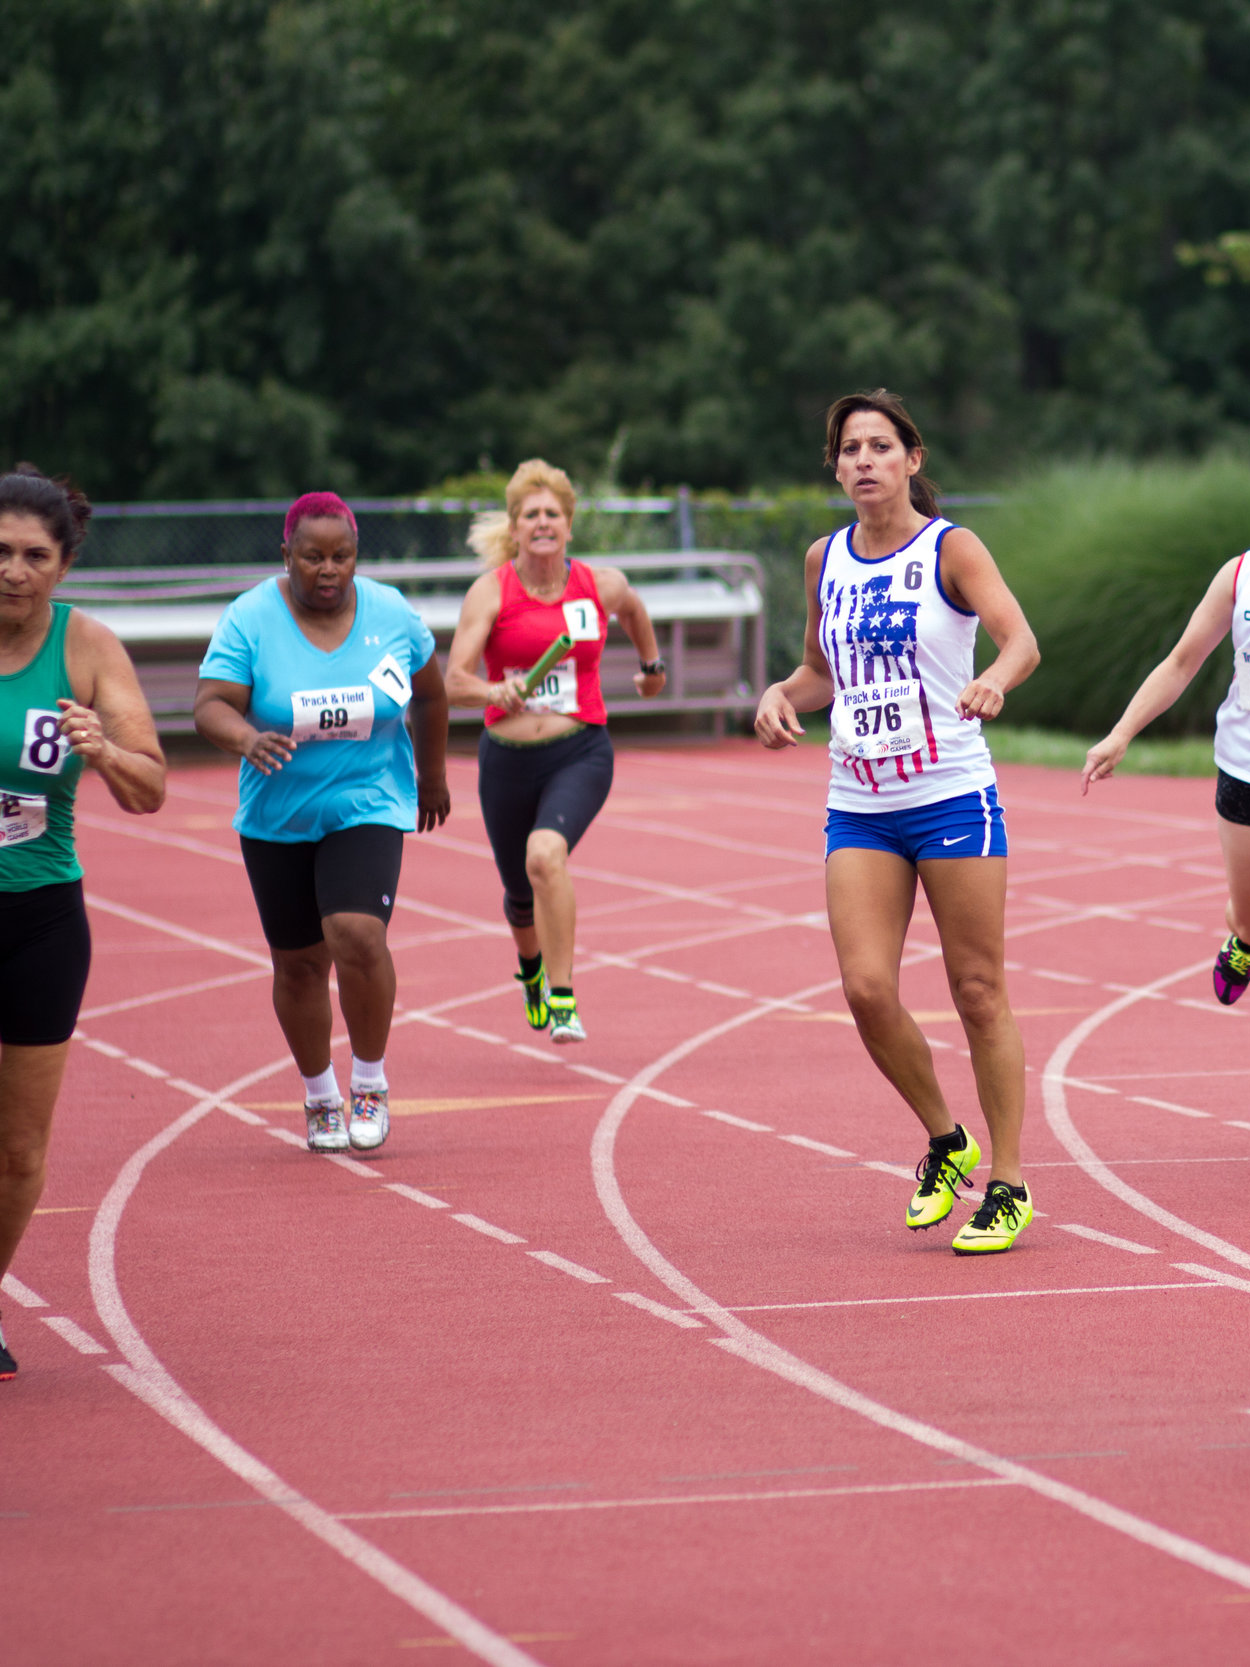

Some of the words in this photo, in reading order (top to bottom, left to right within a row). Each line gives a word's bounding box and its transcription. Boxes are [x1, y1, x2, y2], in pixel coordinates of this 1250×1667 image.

[904, 561, 924, 590] 6
[575, 607, 586, 629] 7
[382, 667, 404, 689] 7
[300, 694, 328, 708] Track
[331, 694, 339, 705] &
[342, 691, 365, 704] Field
[843, 690, 869, 707] Track
[872, 688, 881, 701] &
[884, 684, 910, 699] Field
[319, 708, 348, 730] 69
[853, 702, 902, 737] 376
[29, 715, 62, 769] 8
[890, 737, 911, 745] WORLD
[890, 745, 912, 753] GAMES
